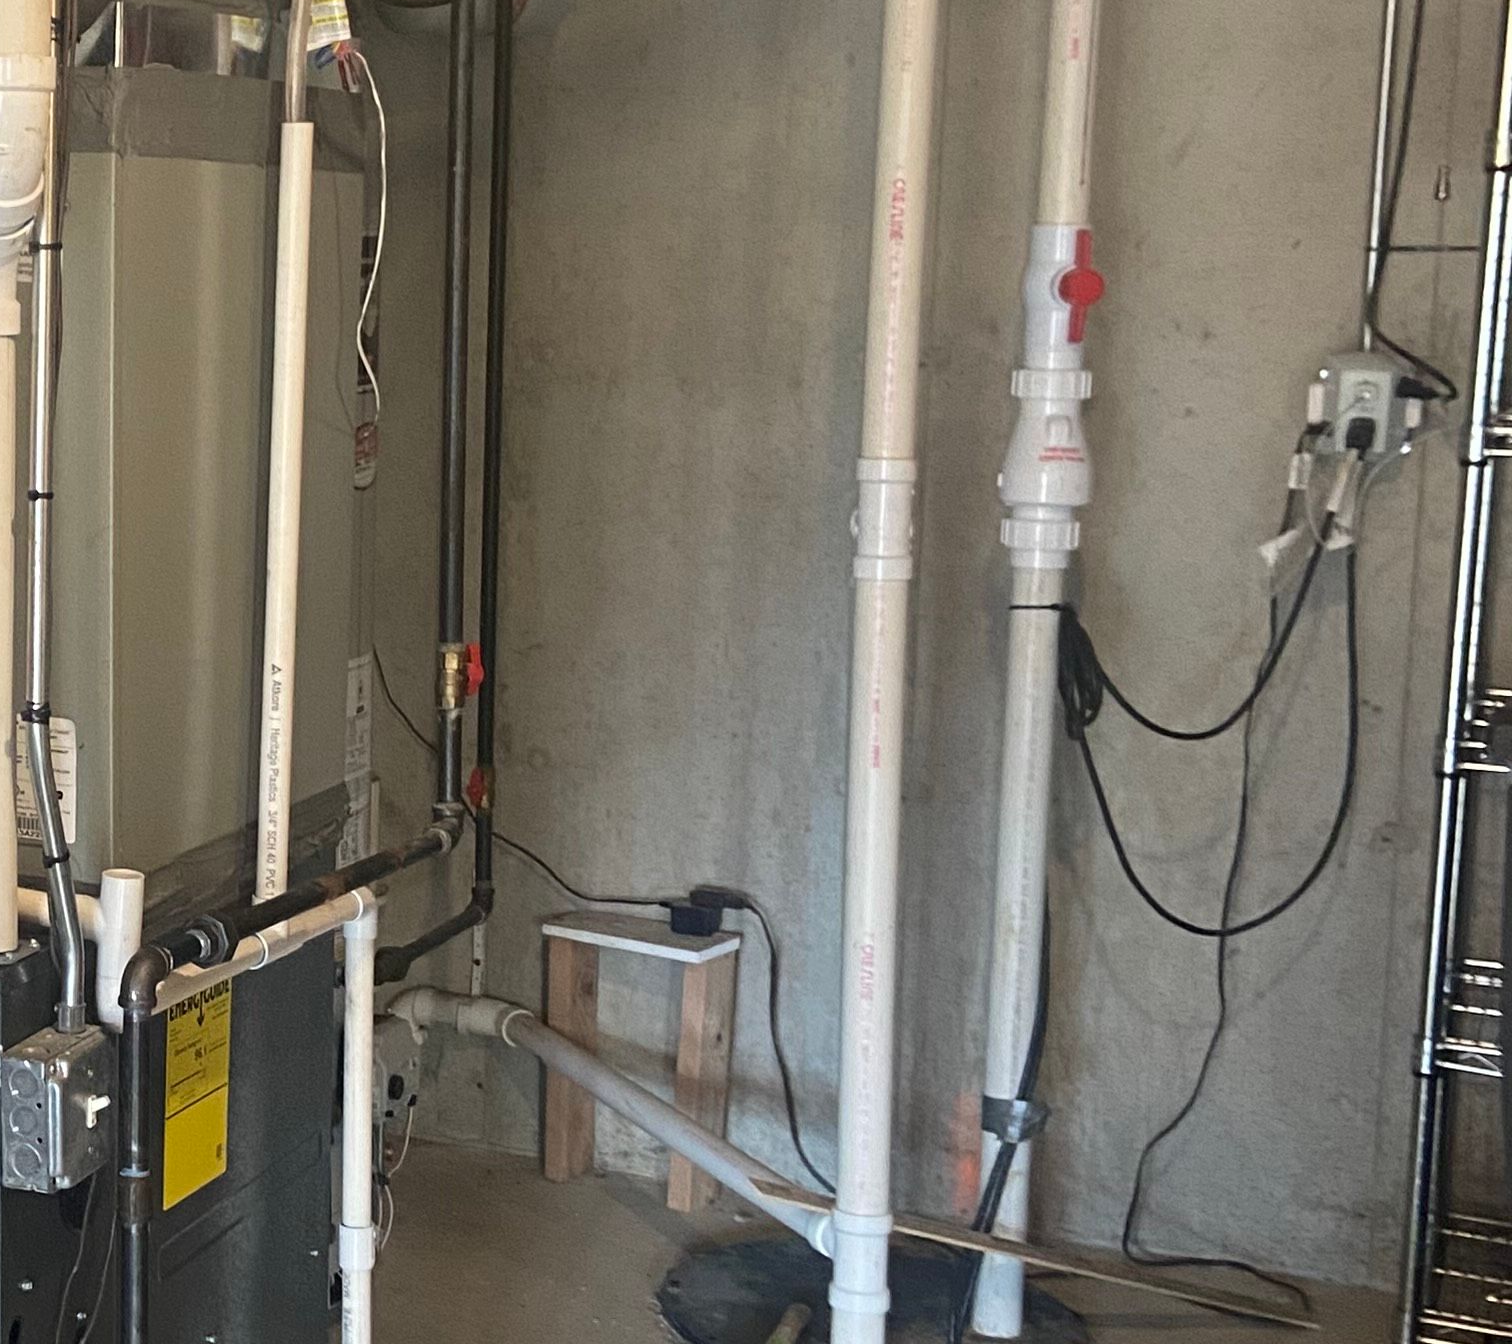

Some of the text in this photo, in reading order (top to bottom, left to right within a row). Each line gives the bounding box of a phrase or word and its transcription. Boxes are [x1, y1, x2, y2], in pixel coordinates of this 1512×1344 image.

[267, 728, 281, 766] Heritage
[268, 768, 280, 802] Plastics
[267, 830, 277, 850] SCH
[266, 852, 277, 864] 40
[265, 869, 276, 889] PVC
